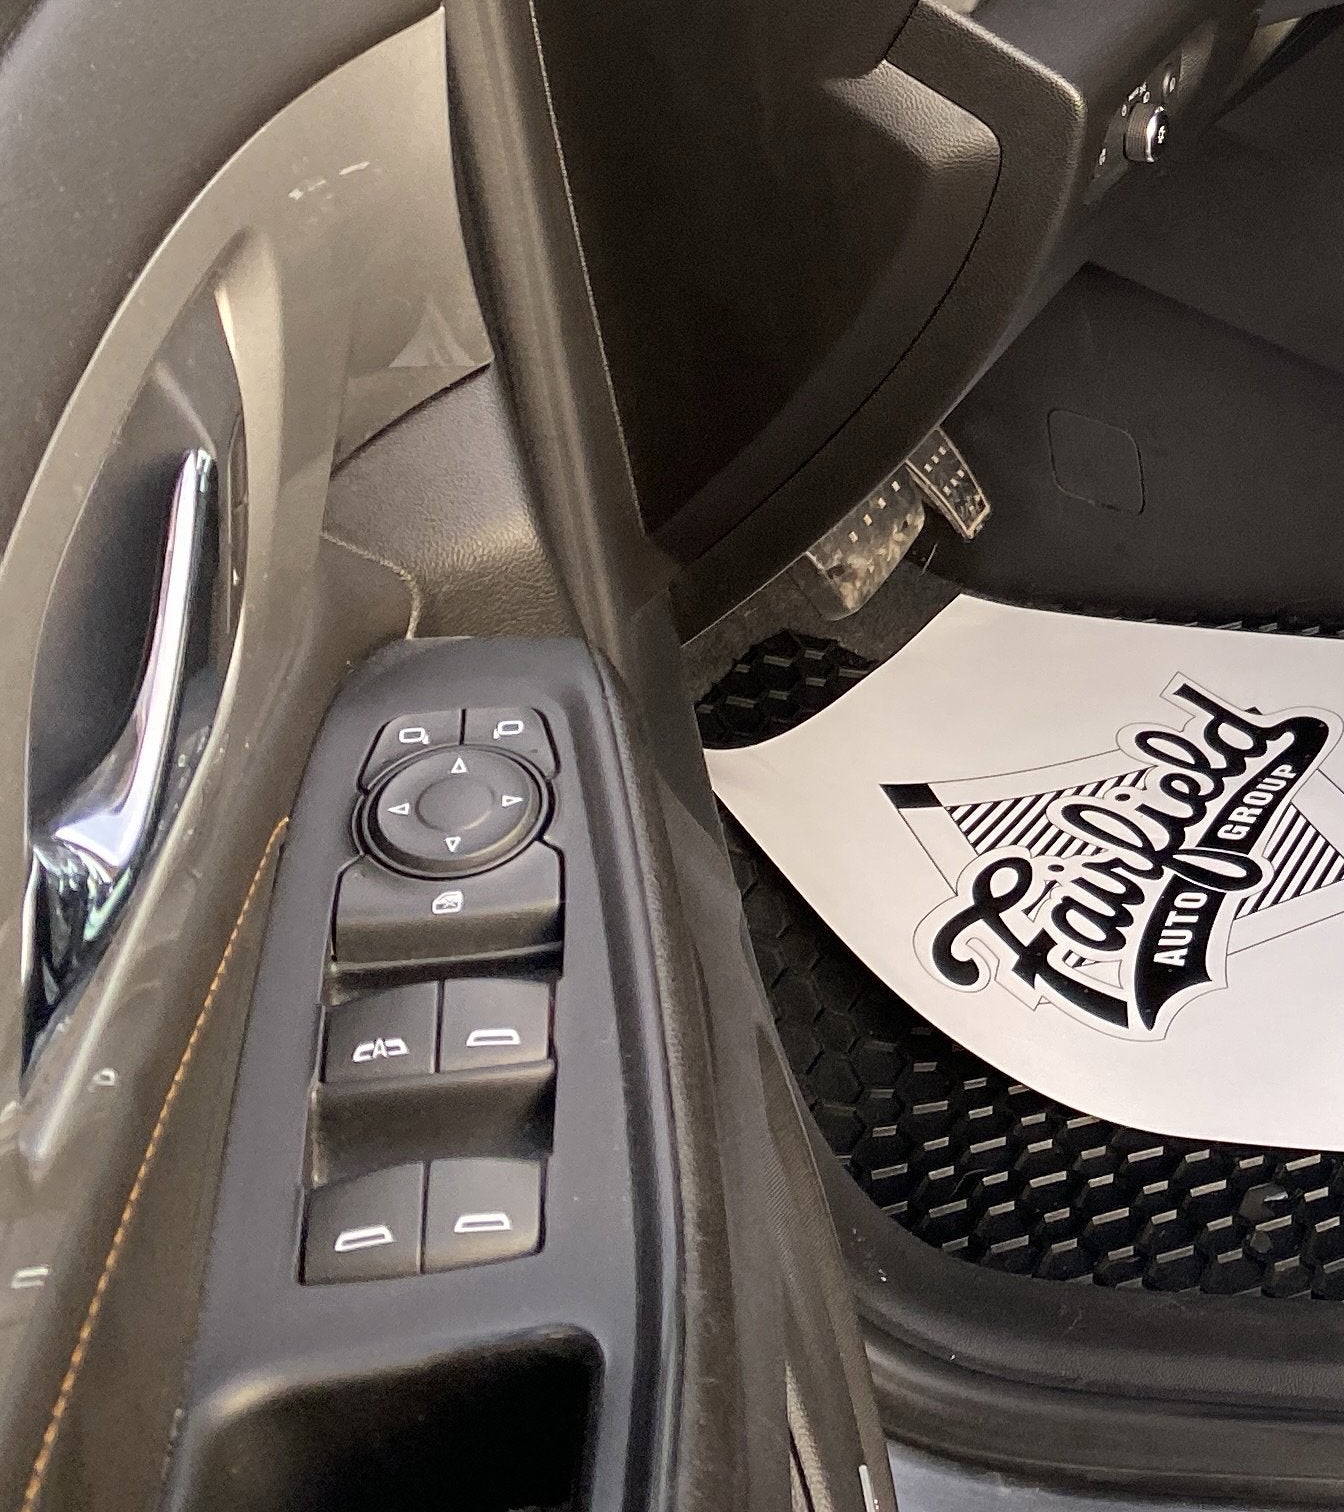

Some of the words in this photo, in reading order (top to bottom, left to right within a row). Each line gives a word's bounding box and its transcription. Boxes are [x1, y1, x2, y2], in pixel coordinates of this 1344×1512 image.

[932, 683, 1280, 1028] Fairfield
[1153, 891, 1209, 967] AUTO
[1217, 763, 1297, 841] GROUP
